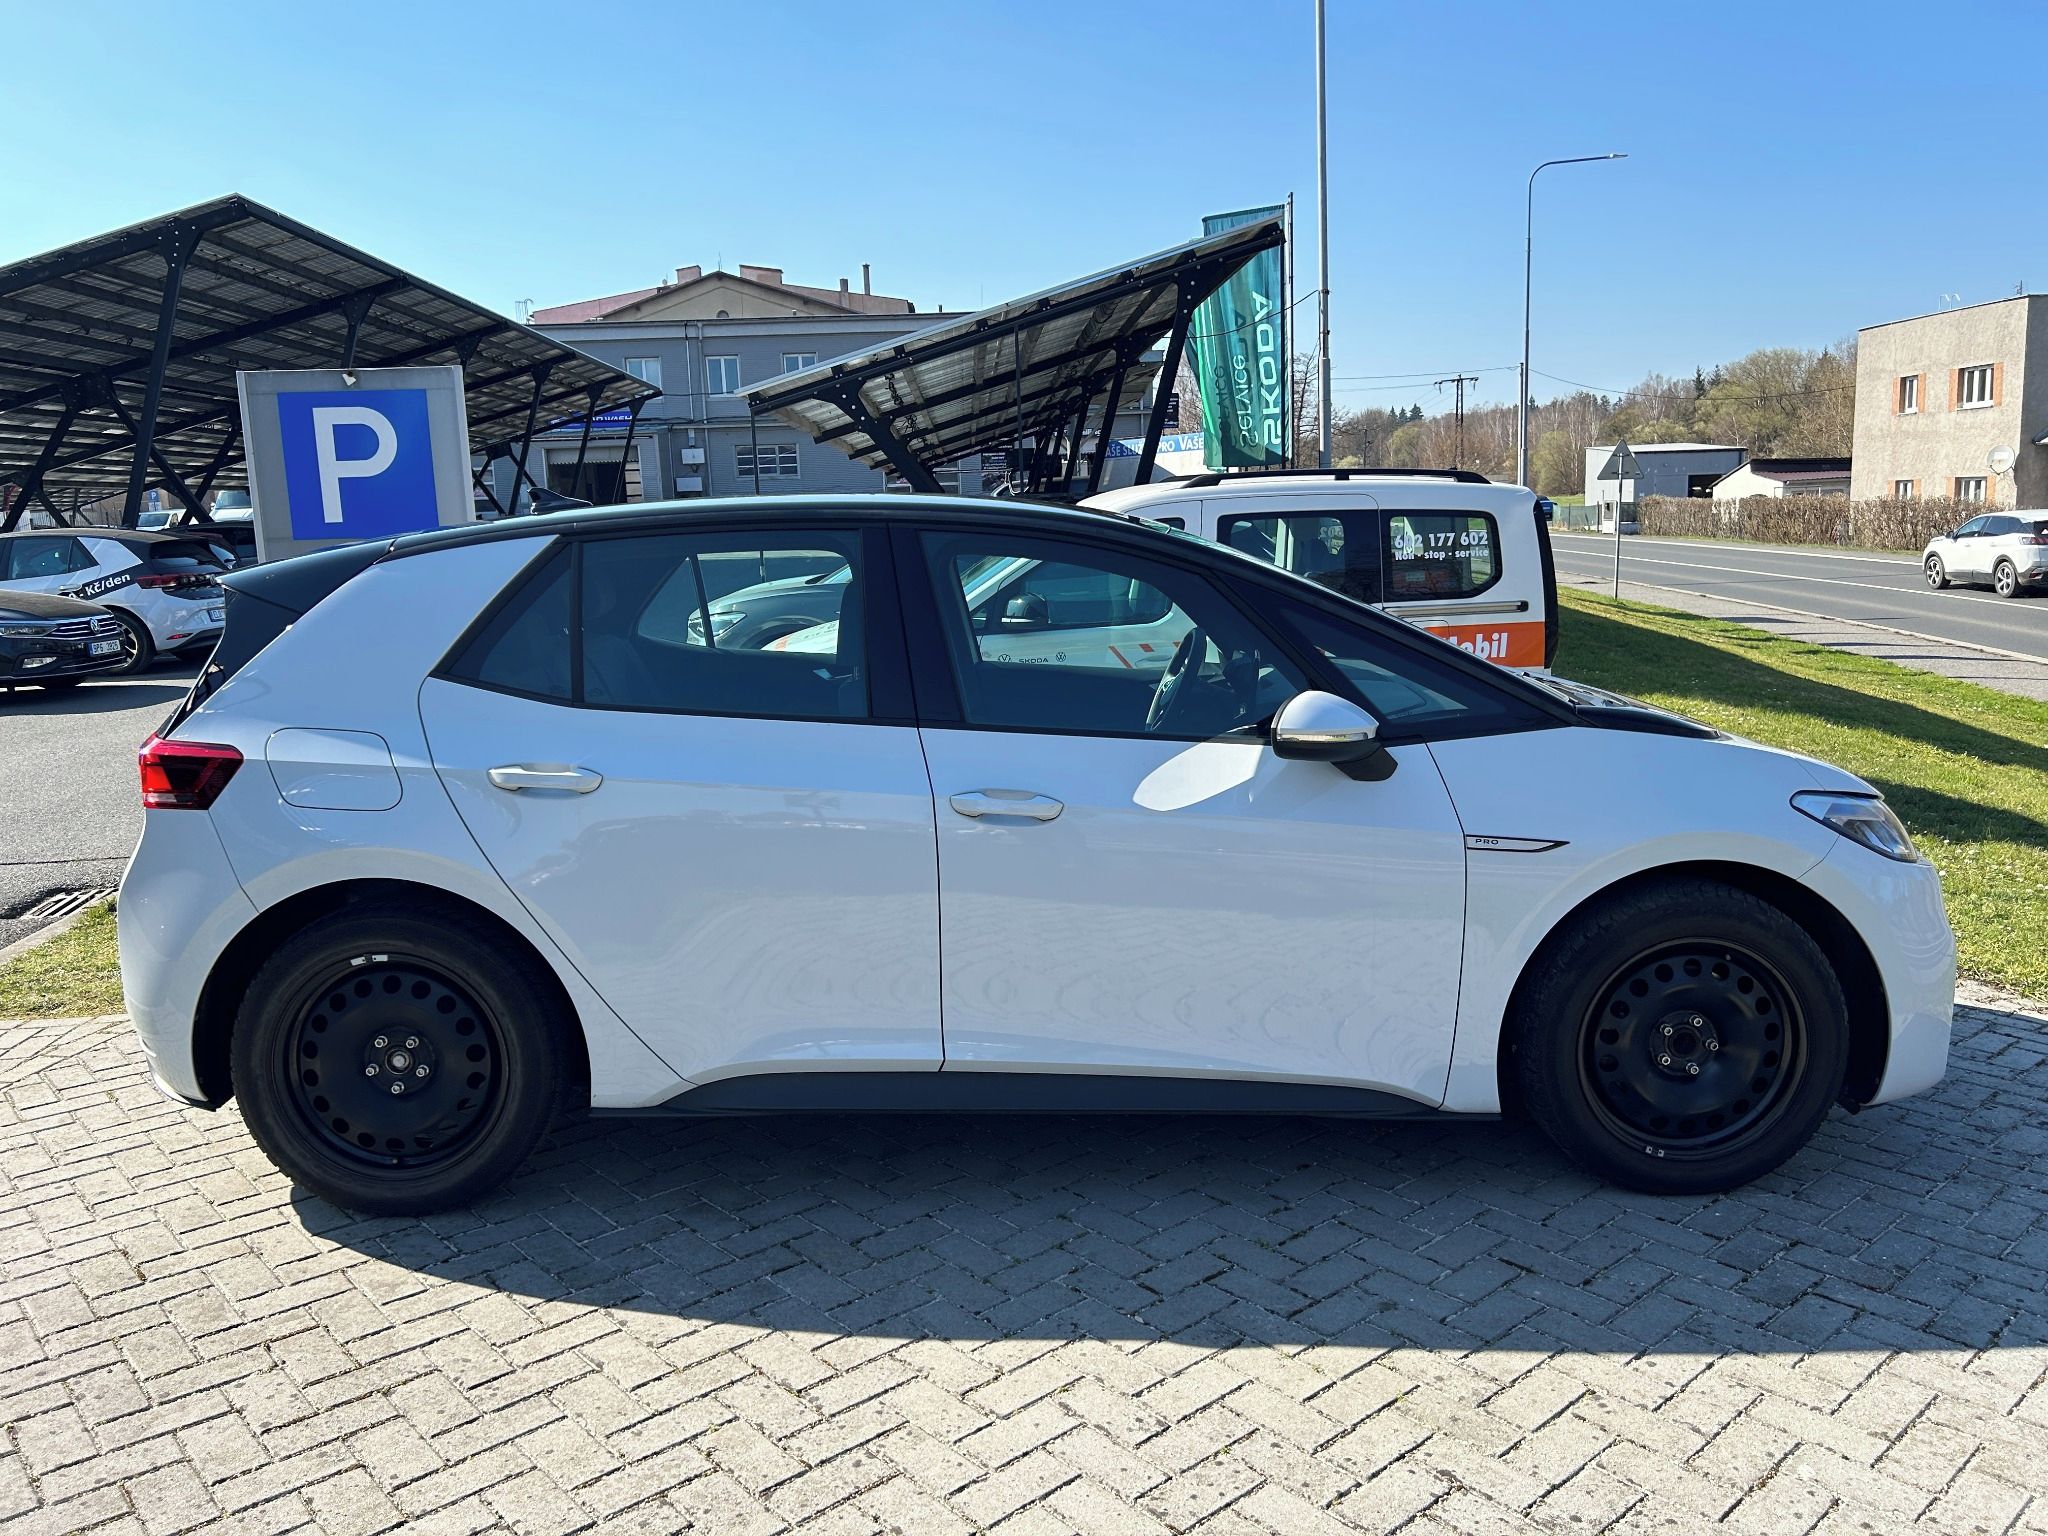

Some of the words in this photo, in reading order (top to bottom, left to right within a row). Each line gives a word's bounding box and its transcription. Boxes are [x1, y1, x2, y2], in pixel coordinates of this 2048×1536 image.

[312, 406, 398, 524] P
[1394, 533, 1423, 548] 602
[1428, 532, 1455, 547] 177
[1460, 531, 1488, 546] 602
[1394, 550, 1415, 560] Non
[1424, 550, 1446, 560] stop
[1454, 547, 1489, 558] service
[85, 574, 130, 596] Kč/den
